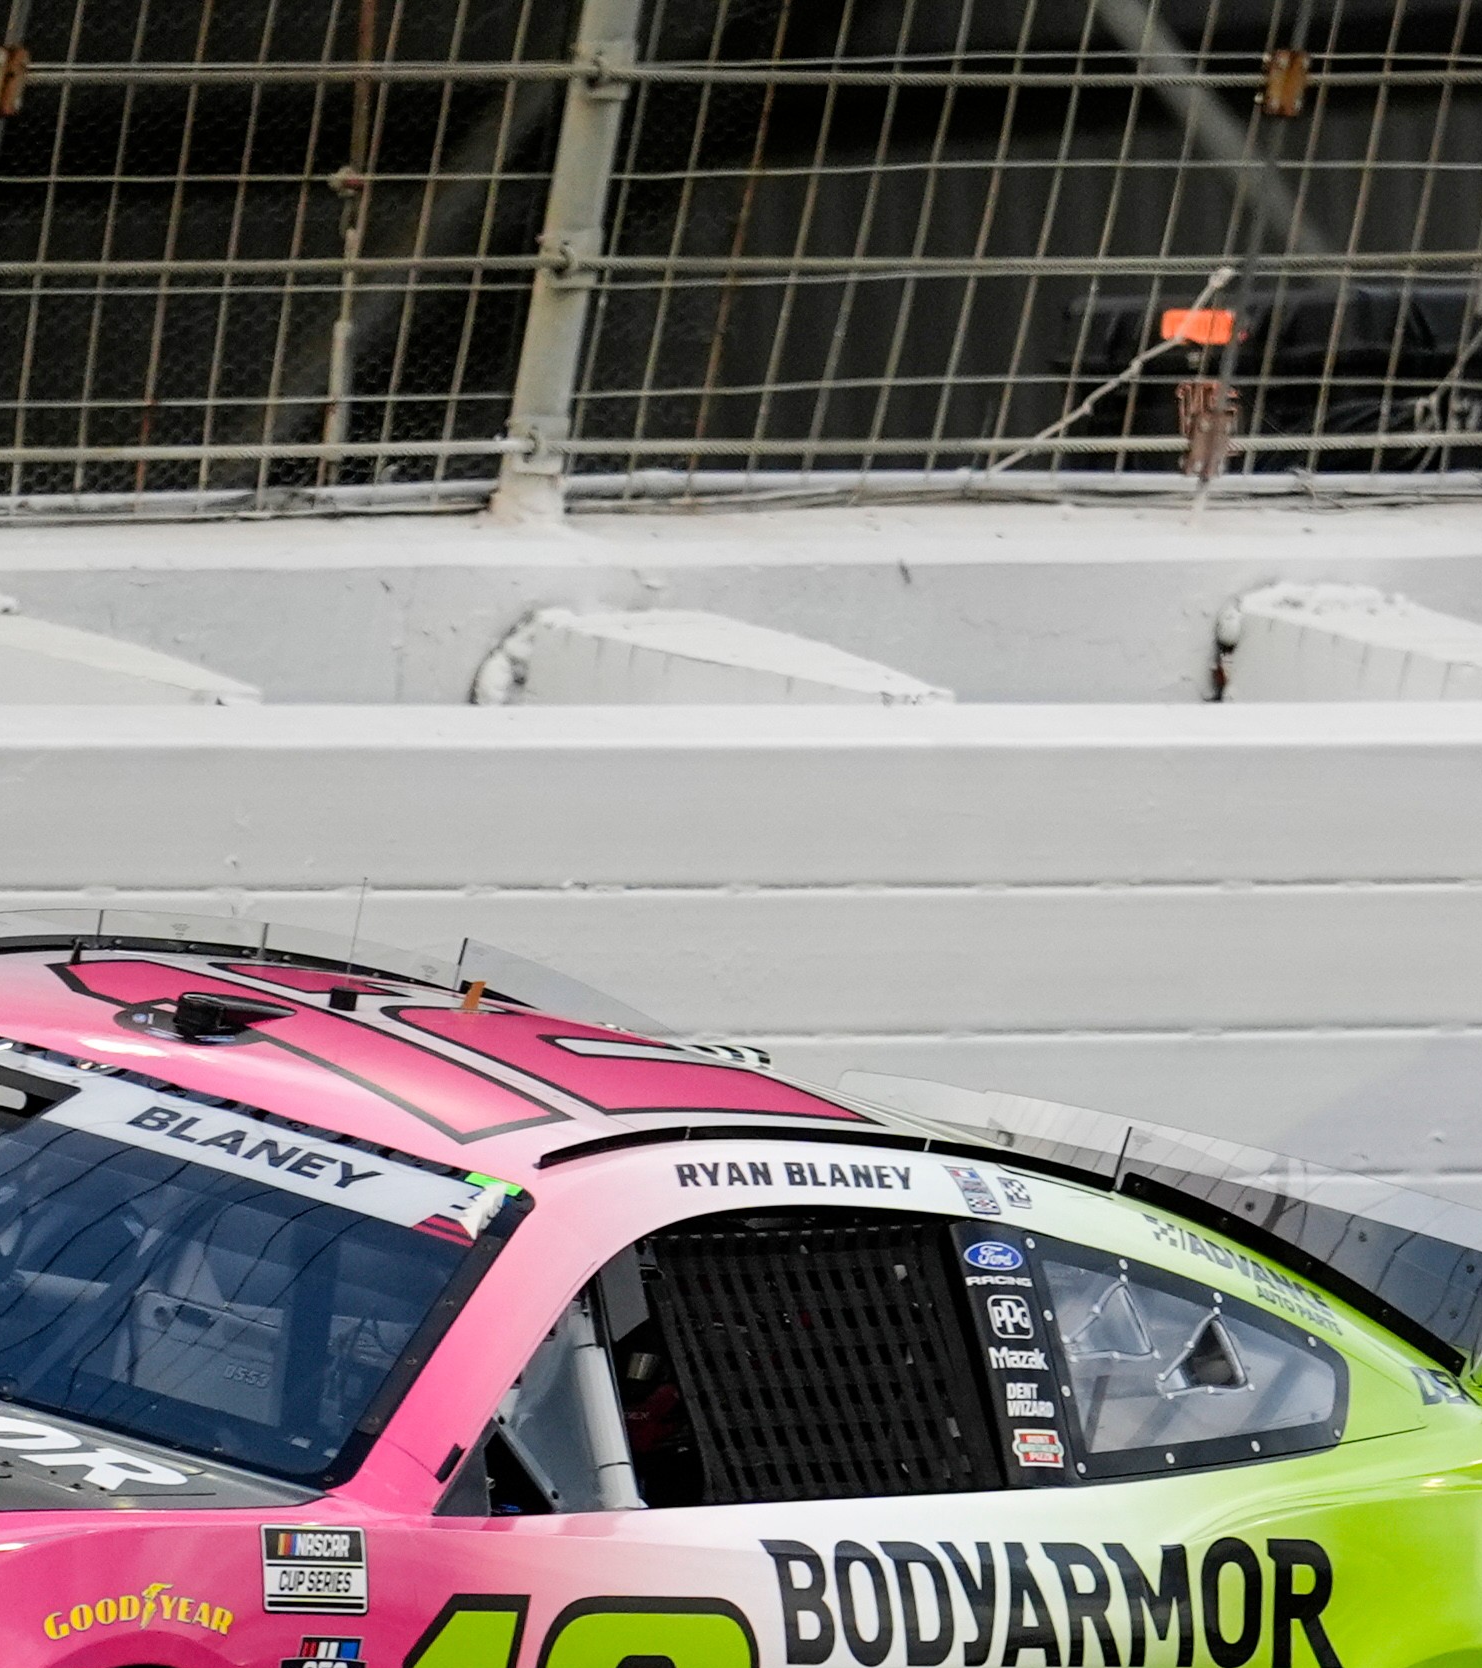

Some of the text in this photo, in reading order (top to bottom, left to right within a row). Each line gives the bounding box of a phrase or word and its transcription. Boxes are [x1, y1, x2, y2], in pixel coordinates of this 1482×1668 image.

[125, 1105, 384, 1191] BLANEY
[675, 1161, 911, 1190] RYAN BLANEY
[977, 1244, 1014, 1268] Ford
[965, 1275, 1034, 1288] RACING
[992, 1299, 1032, 1334] PPG
[987, 1346, 1050, 1371] Mazak
[1006, 1382, 1039, 1400] DENT
[1006, 1401, 1056, 1418] WIZARD
[296, 1533, 352, 1558] NASCAR
[279, 1570, 353, 1594] CUP SERIES
[42, 1583, 235, 1640] GOODYEAR
